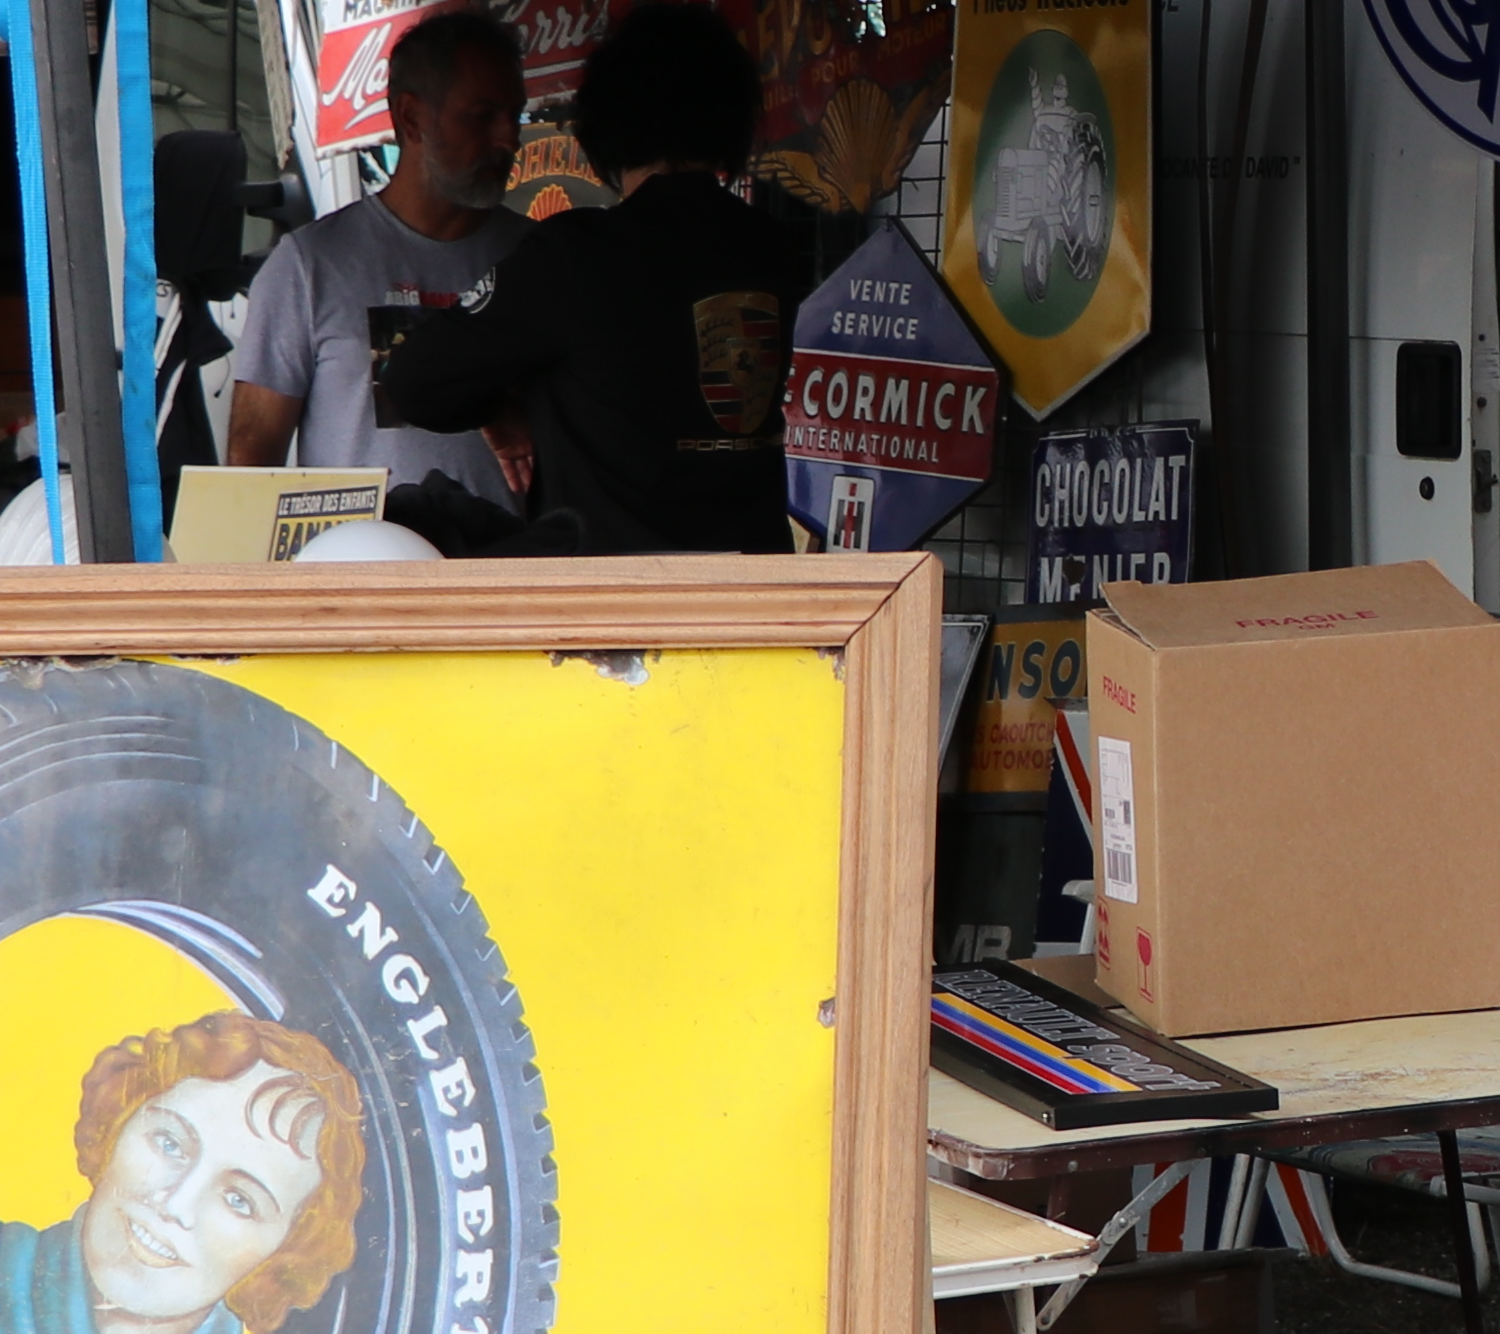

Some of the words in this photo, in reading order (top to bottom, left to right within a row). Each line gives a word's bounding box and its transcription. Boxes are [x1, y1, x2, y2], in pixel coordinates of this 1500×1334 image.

[1245, 156, 1290, 179] DAVID
[850, 280, 912, 305] VENTE
[831, 312, 919, 339] SERVICE
[803, 369, 987, 434] CORMICK
[784, 425, 939, 463] INTERNATIONAL
[278, 497, 290, 515] LE
[290, 493, 322, 515] TRÉSOR
[322, 493, 339, 512] DES
[339, 489, 377, 512] ENFANTS
[1035, 456, 1186, 529] CHOCOLAT
[1236, 610, 1379, 628] FRAGILE
[1102, 675, 1137, 714] FRAGILE
[934, 969, 1121, 1040] RENAULT
